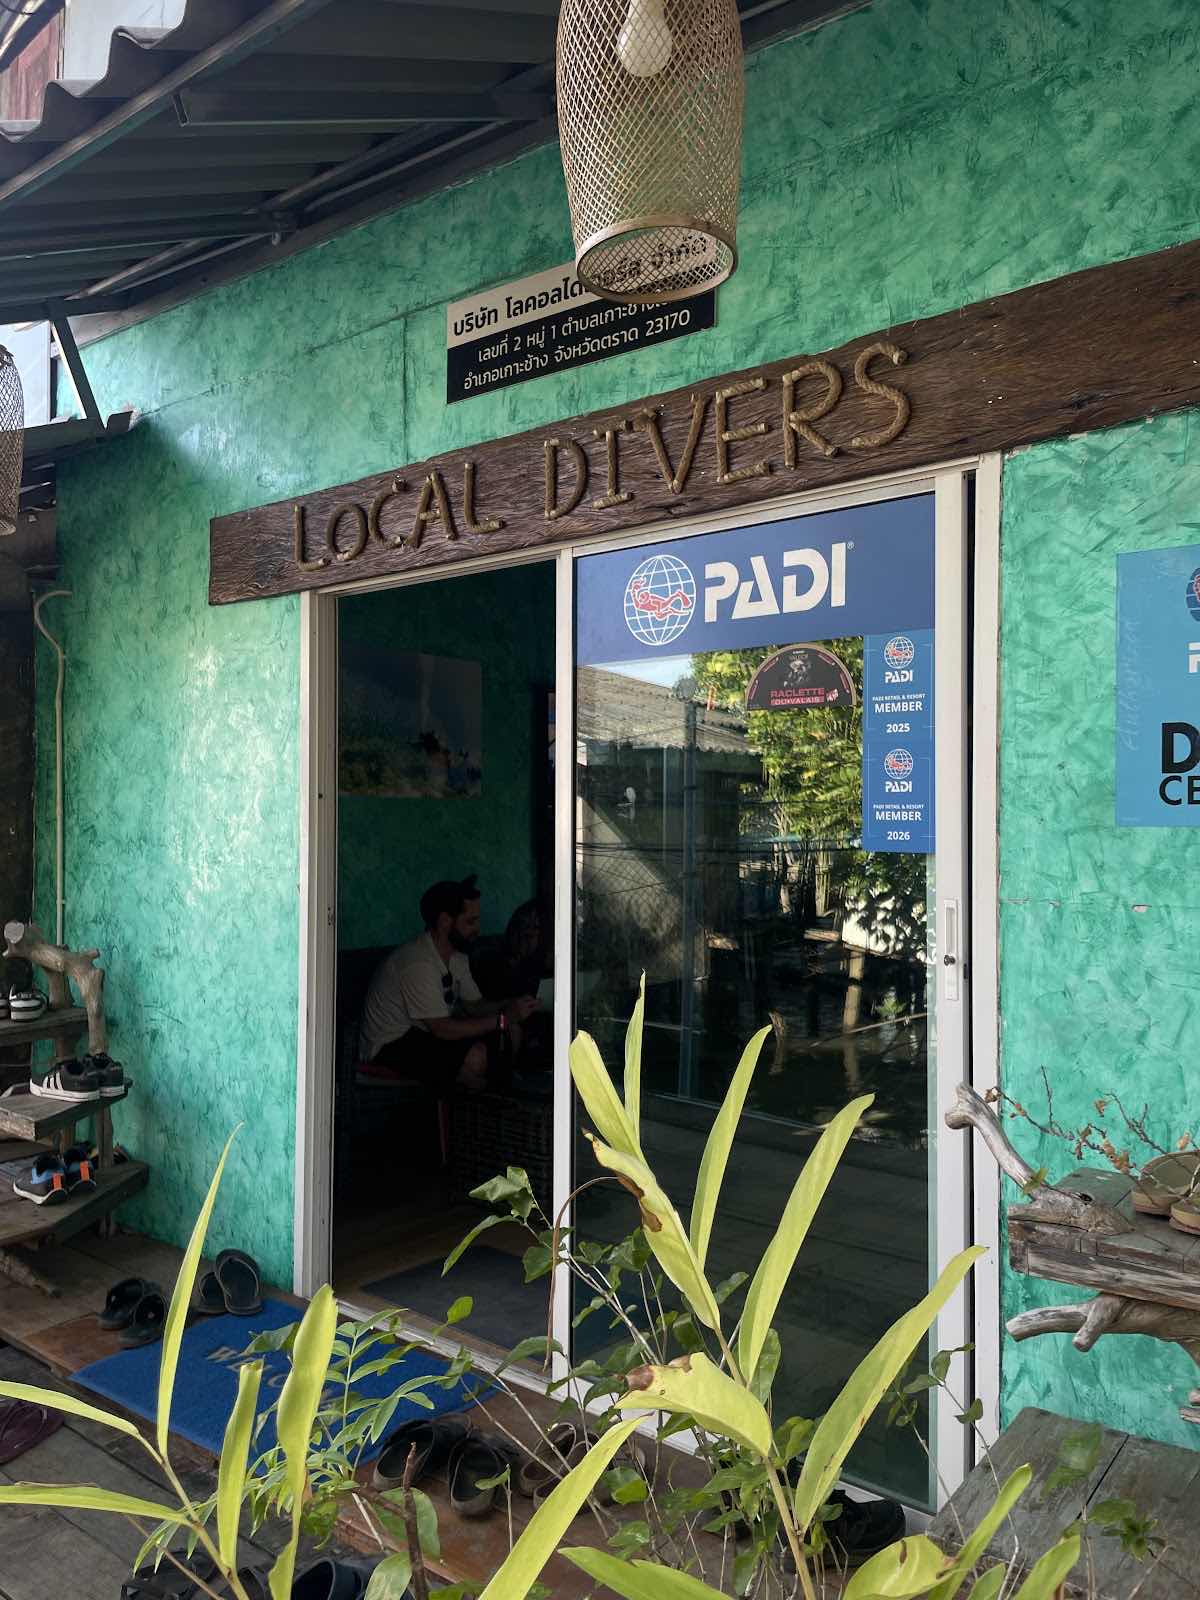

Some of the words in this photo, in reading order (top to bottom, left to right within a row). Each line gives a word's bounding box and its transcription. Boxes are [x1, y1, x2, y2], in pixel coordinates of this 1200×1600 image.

[453, 306, 498, 336] บริษัท
[463, 353, 549, 390] อำเภอเกาะช้าง
[554, 325, 639, 363] จังหวัดตราด
[645, 309, 691, 336] 23170
[478, 334, 508, 362] เลขที่
[513, 336, 521, 350] 2
[526, 331, 545, 351] หมู่
[551, 325, 557, 340] 1
[293, 463, 505, 572] LOCAL
[544, 341, 911, 520] DIVERS
[884, 670, 914, 683] PADI
[874, 701, 923, 713] MEMBER
[886, 723, 910, 733] 2025
[885, 781, 912, 792] PADI
[875, 811, 922, 821] MEMBER
[887, 831, 911, 841] 2026
